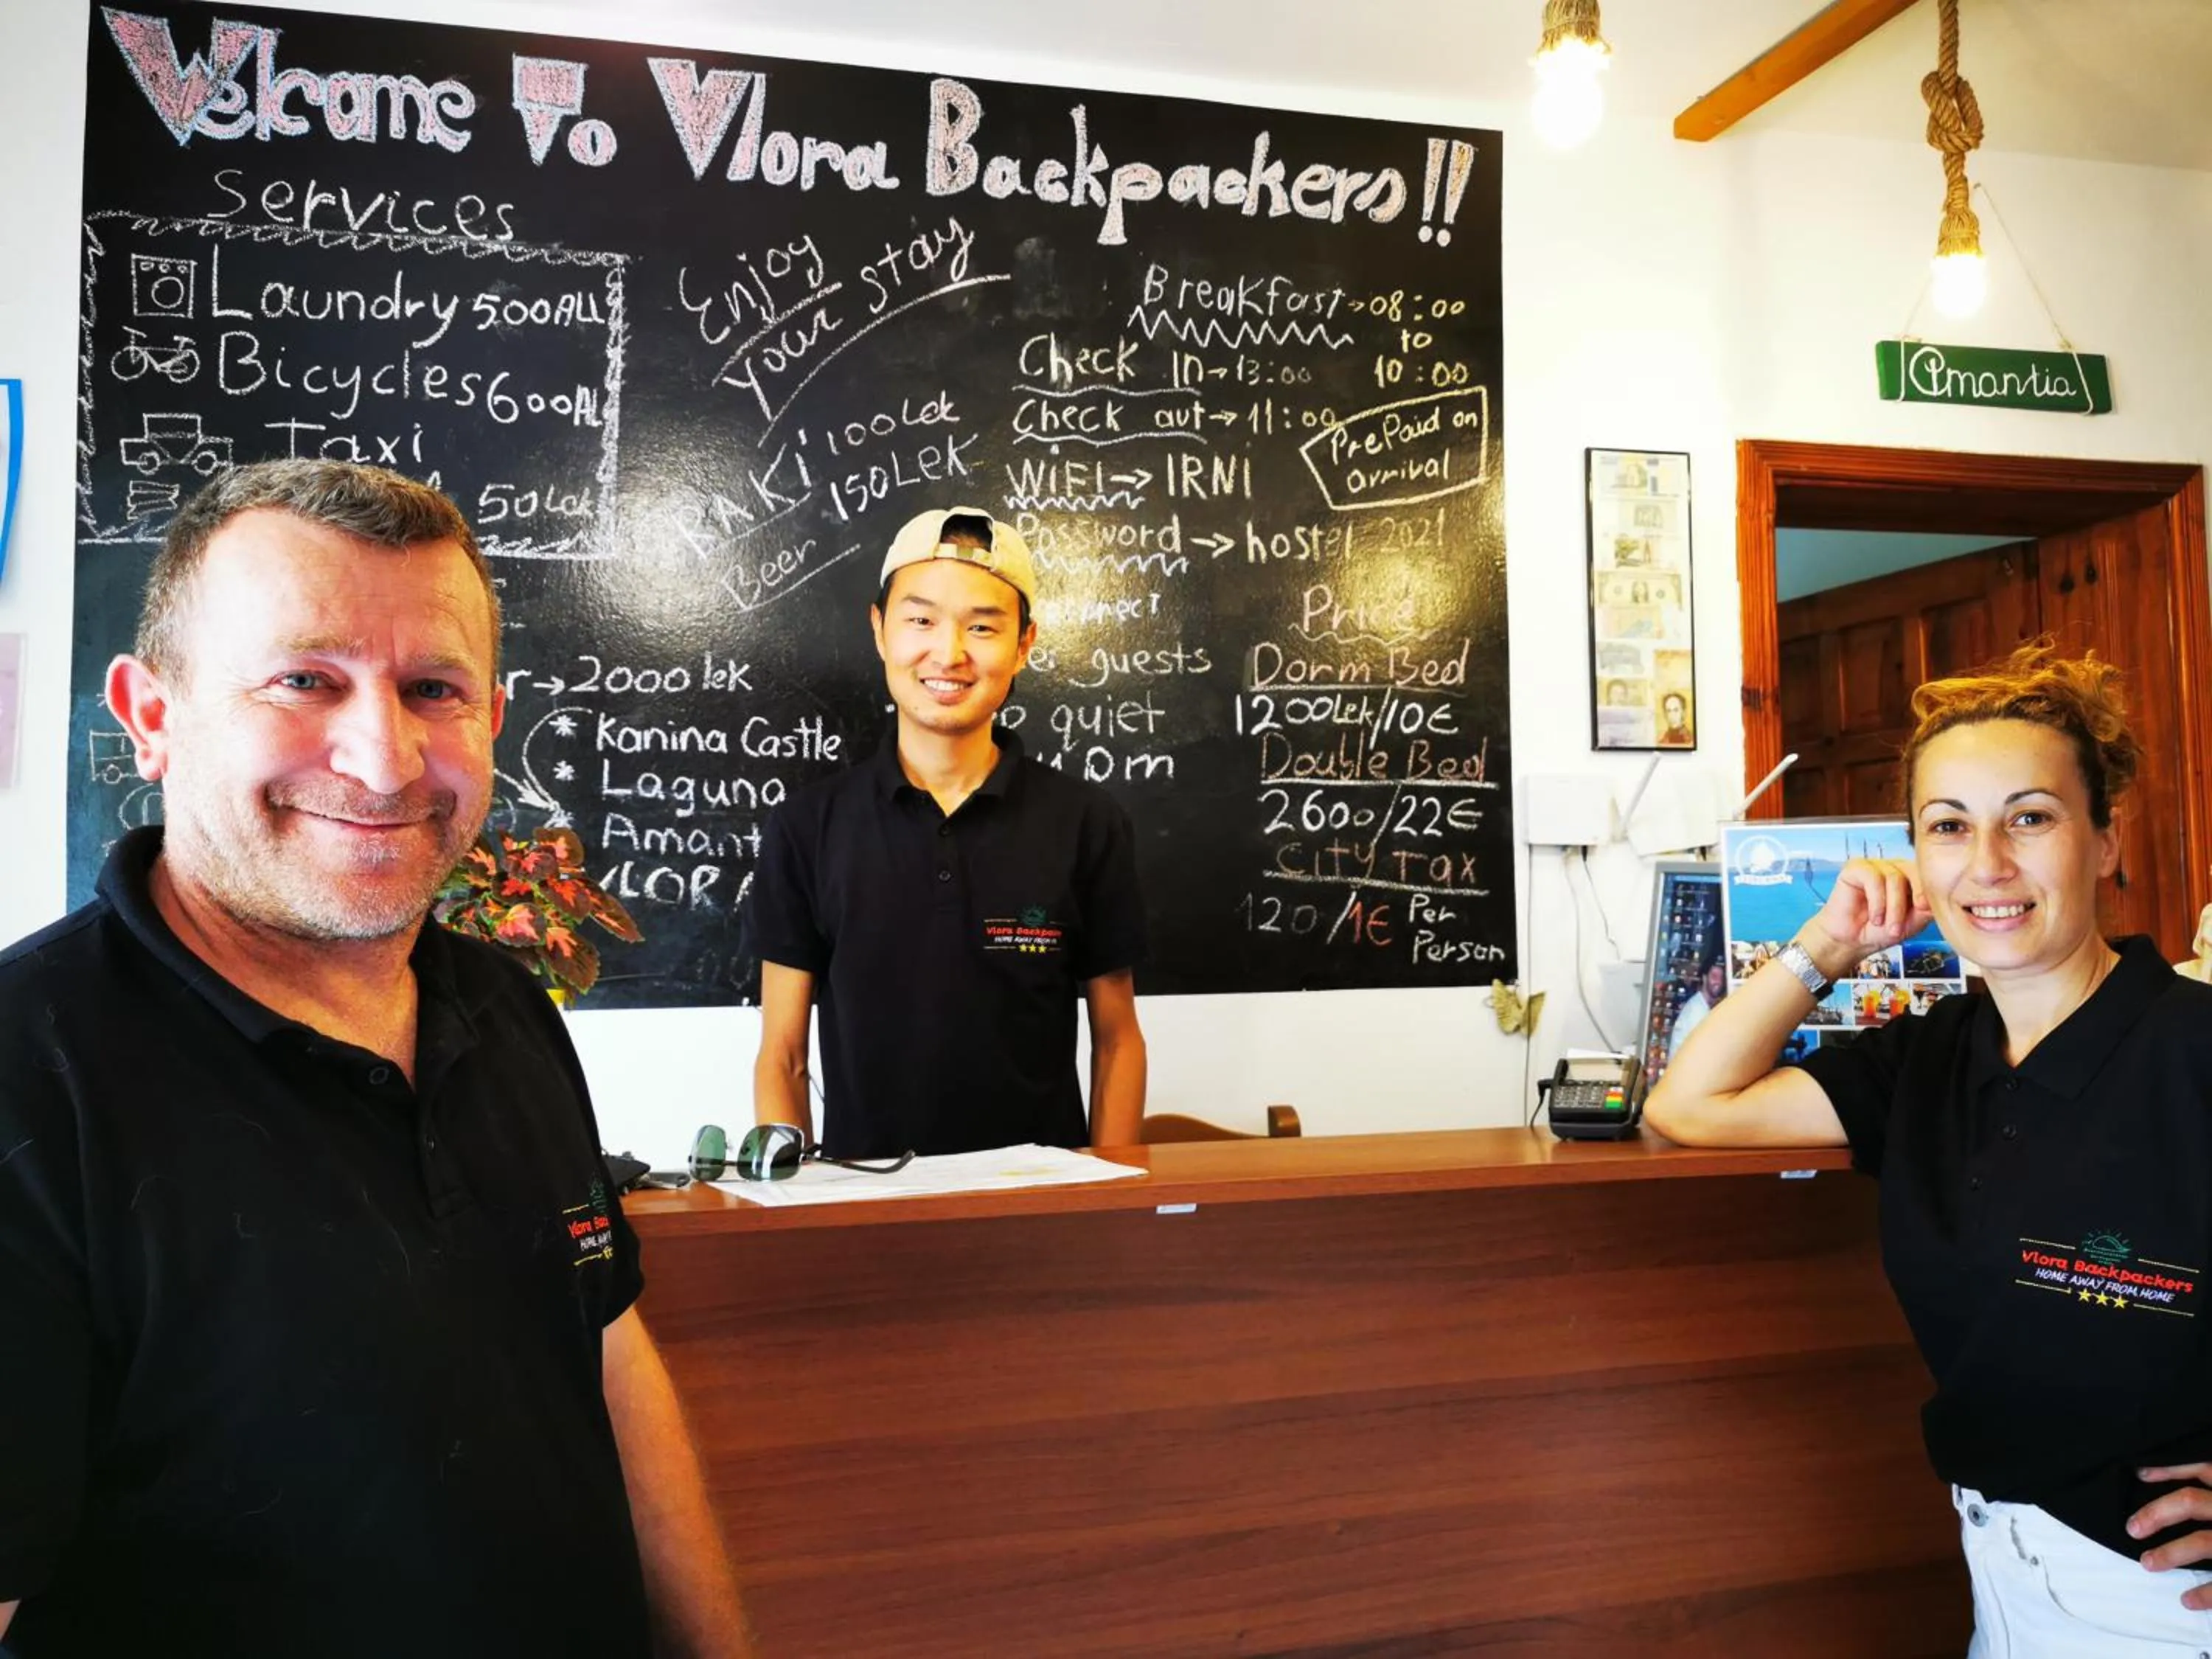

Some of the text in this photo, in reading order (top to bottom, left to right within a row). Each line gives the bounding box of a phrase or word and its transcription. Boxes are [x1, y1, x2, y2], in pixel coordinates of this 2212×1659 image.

[512, 52, 617, 166] To
[646, 56, 900, 191] Vlora
[207, 169, 515, 241] Services
[212, 243, 459, 349] Laundry
[679, 234, 824, 345] Enjoy
[1019, 331, 1139, 389] Check
[1400, 328, 1433, 353] to
[219, 330, 483, 420] Bicycles
[1012, 398, 1124, 434] Check
[1452, 411, 1478, 428] on
[265, 417, 425, 465] Taxi
[1167, 452, 1251, 500] IRNI
[1245, 521, 1354, 563] hostel
[568, 655, 692, 693] 2000
[1069, 641, 1212, 687] guests
[1253, 637, 1470, 687] Dorm Bed
[596, 711, 842, 762] Kanina Castle
[1050, 689, 1166, 752] quiet
[1262, 732, 1487, 780] Double Bed
[601, 758, 787, 818] Laguna
[601, 812, 764, 858] Amant
[1409, 893, 1456, 923] Per
[2022, 1249, 2067, 1271] Vlora
[2073, 1259, 2194, 1293] Backpackers
[2035, 1267, 2175, 1304] HOME AWAY FROM HOME
